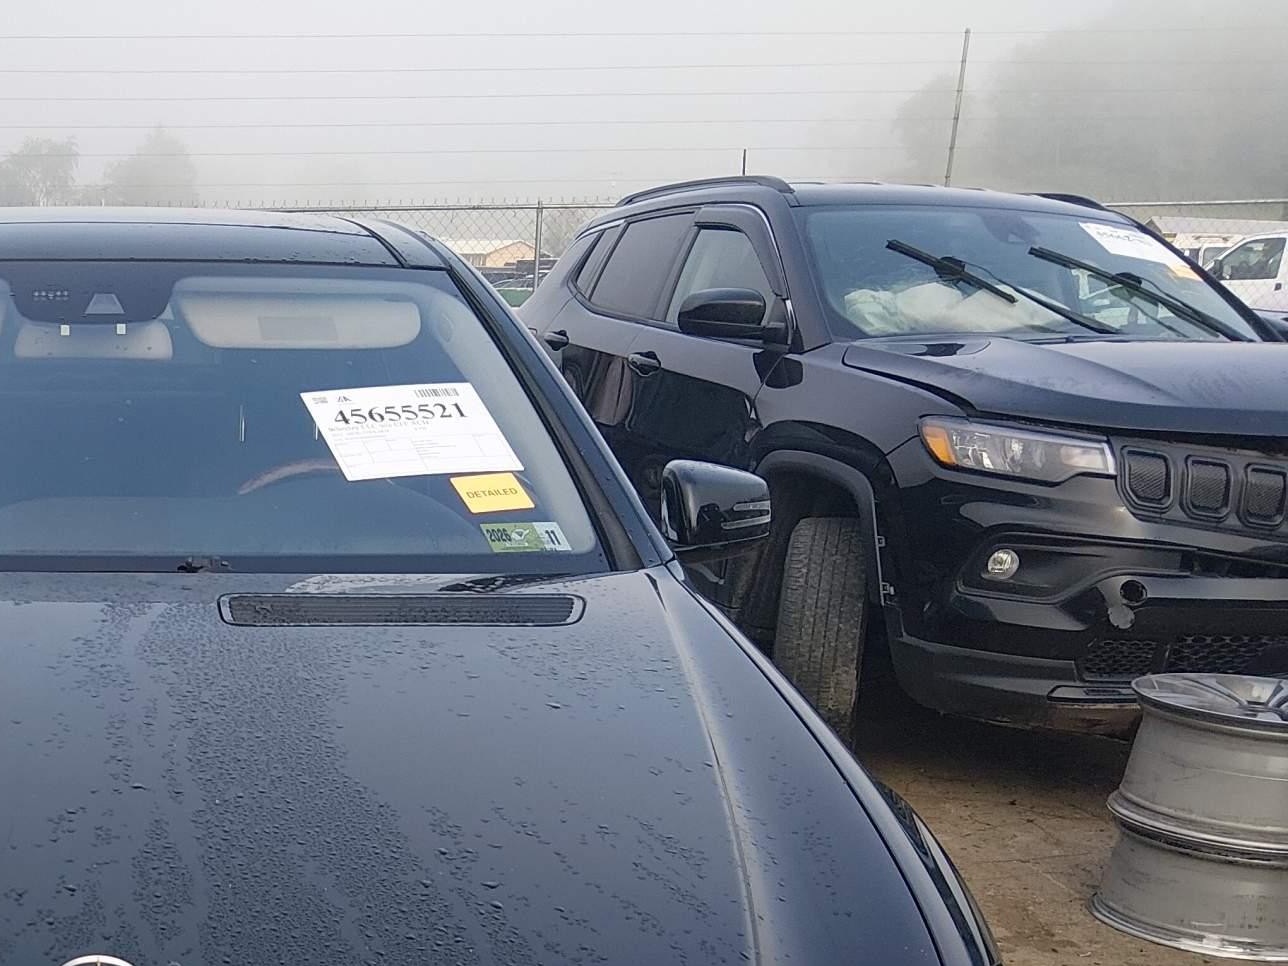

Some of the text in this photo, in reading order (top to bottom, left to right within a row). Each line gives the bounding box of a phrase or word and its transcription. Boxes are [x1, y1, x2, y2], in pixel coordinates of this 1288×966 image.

[334, 402, 468, 425] 45655521
[466, 487, 518, 500] DETAILED
[486, 528, 562, 546] 2026 11
